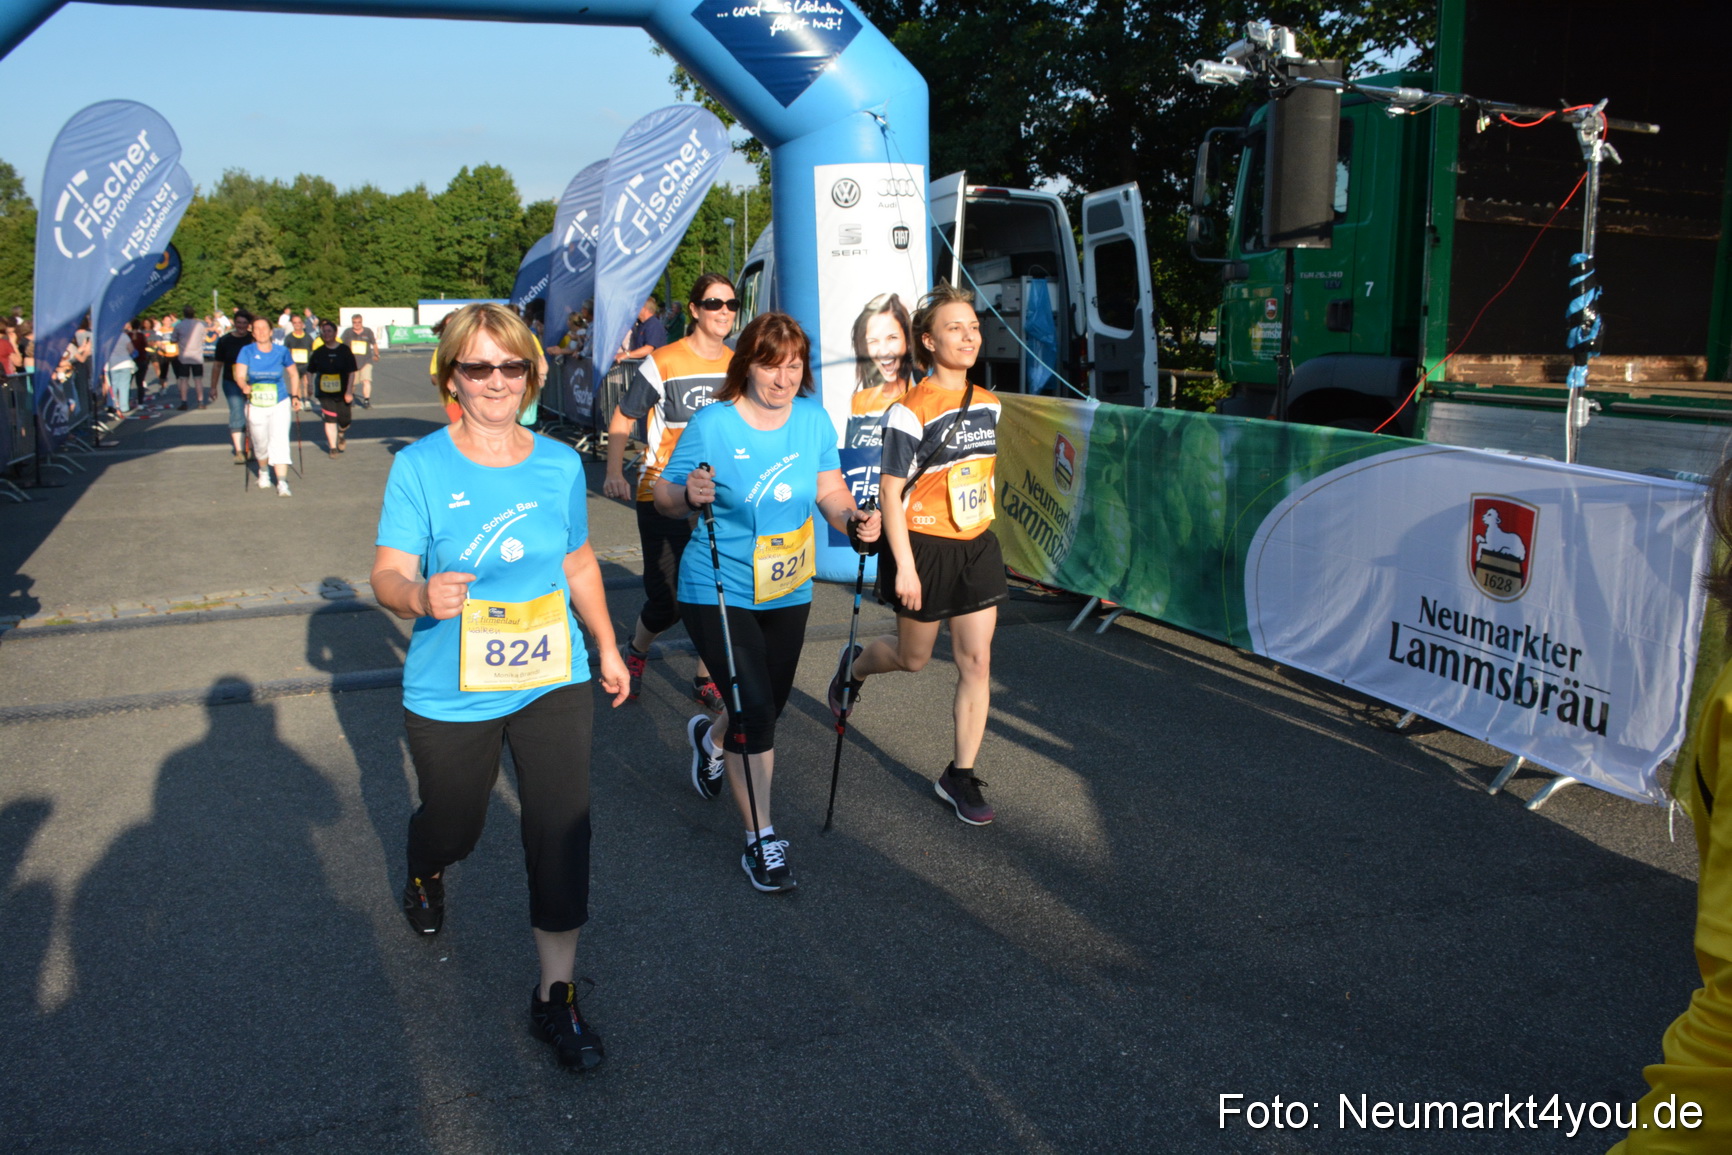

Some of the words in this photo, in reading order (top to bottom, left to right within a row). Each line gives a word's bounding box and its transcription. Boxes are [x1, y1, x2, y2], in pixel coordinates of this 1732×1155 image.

[732, 1, 762, 17] und
[812, 18, 842, 31] mit!
[74, 129, 152, 240] Fischer
[101, 152, 160, 239] AUTOMOBILE
[632, 128, 704, 236] Fischer
[658, 148, 712, 234] AUTOMOBILE
[831, 249, 868, 257] SEAT
[894, 230, 909, 245] FIAT
[1364, 281, 1375, 297] 7
[744, 481, 763, 504] Team
[759, 462, 783, 481] Schick
[782, 452, 800, 464] Bau
[958, 483, 987, 512] 1646
[459, 533, 485, 562] Team
[482, 508, 517, 533] Schick
[515, 501, 539, 513] Bau
[771, 548, 806, 583] 821
[1483, 572, 1513, 593] 1628
[485, 634, 551, 666] 824
[1418, 595, 1582, 673] Neumarkter
[1388, 620, 1611, 738] Lammsbräu
